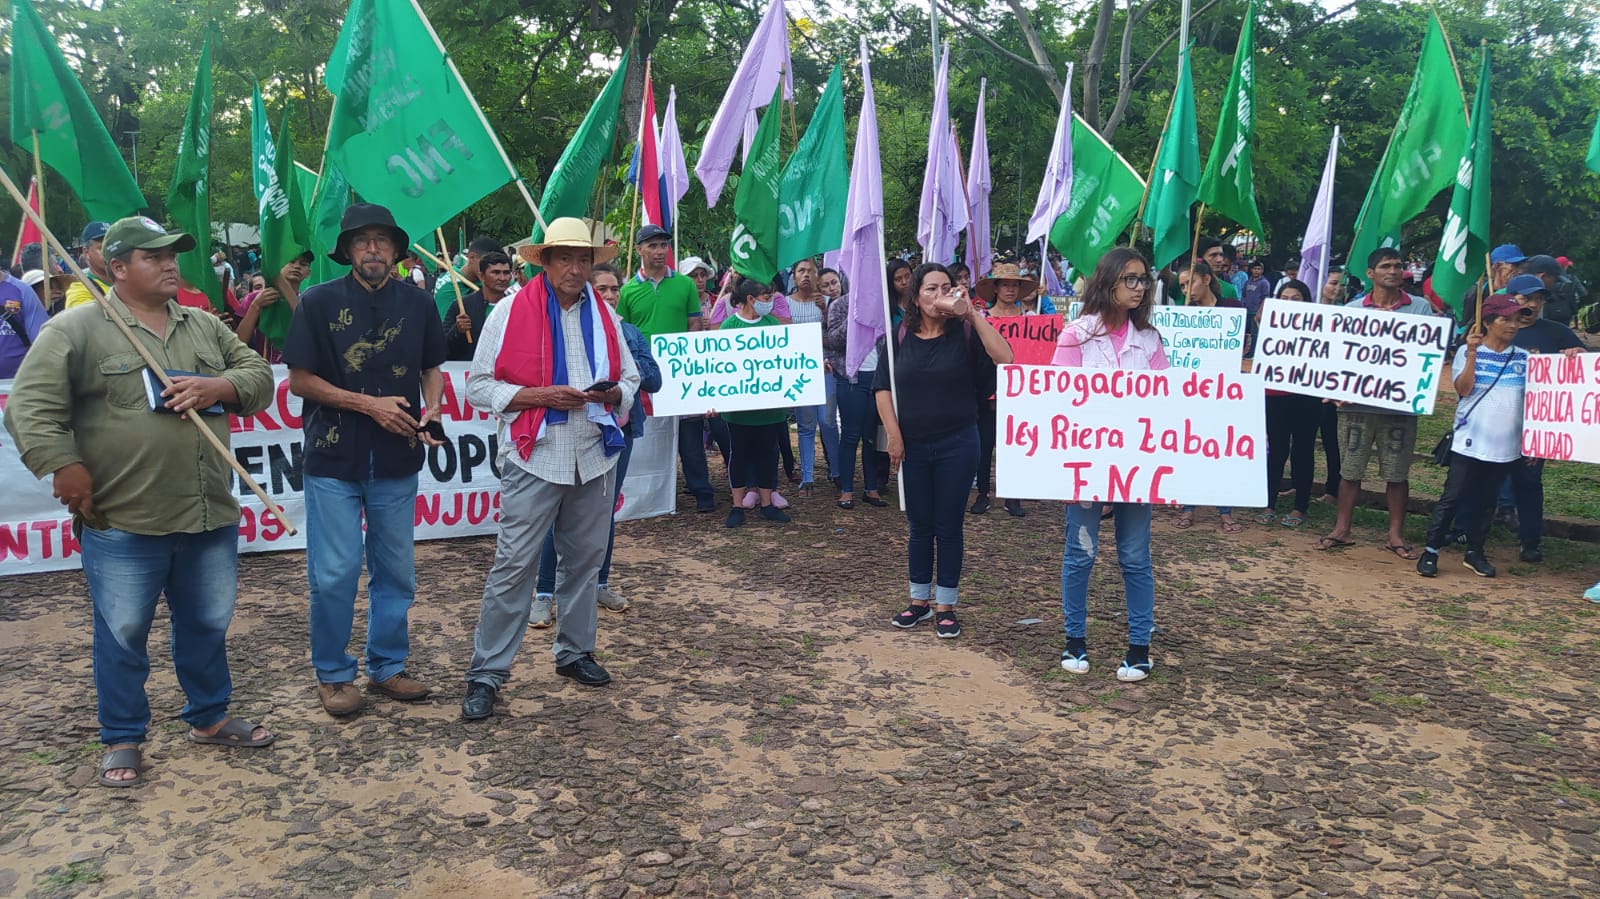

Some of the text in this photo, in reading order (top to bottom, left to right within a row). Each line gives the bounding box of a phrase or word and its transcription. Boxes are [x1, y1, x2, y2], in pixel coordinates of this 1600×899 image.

[1023, 317, 1062, 343] luch
[1227, 314, 1242, 337] y
[1269, 310, 1446, 351] LUCHA PROLONGADA
[668, 352, 819, 382] Pública gratuita
[1262, 336, 1408, 368] CONTRA TODAS
[1527, 356, 1553, 385] POR
[1556, 356, 1586, 385] UNA
[783, 373, 812, 402] FNC
[1050, 414, 1124, 450] Riera
[1137, 418, 1255, 460] Zabala
[1521, 428, 1574, 460] CALIDAD
